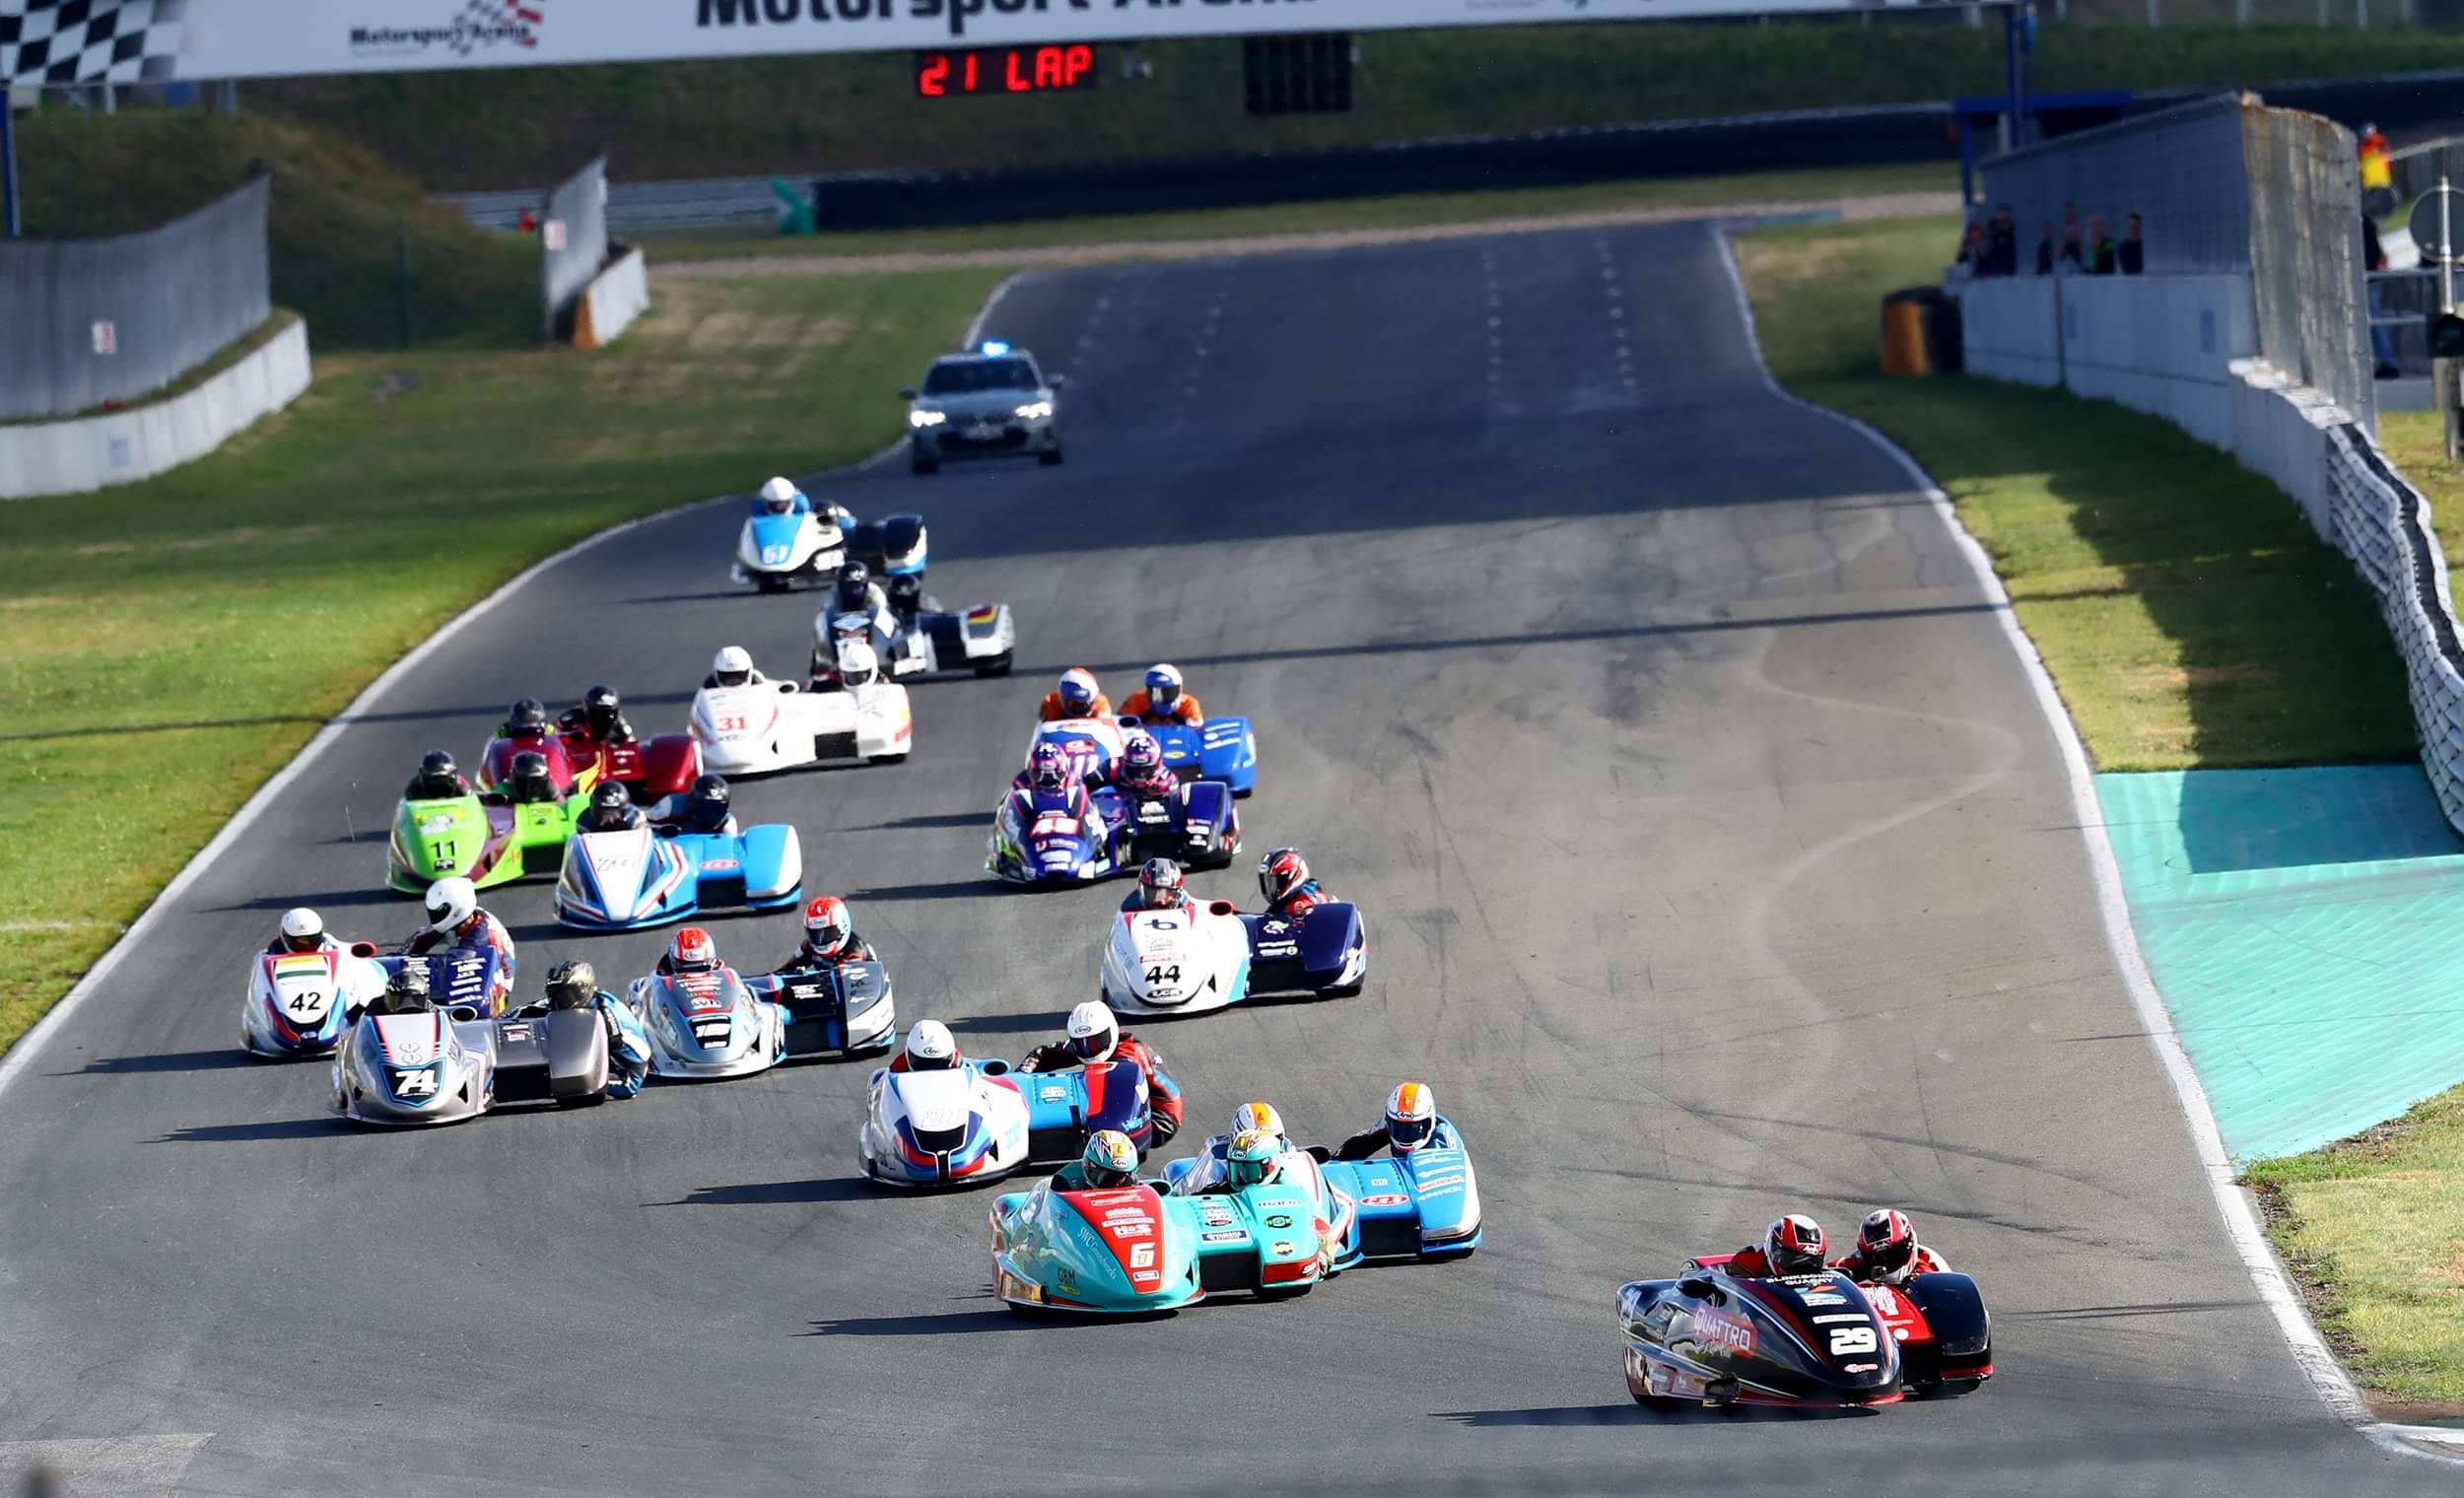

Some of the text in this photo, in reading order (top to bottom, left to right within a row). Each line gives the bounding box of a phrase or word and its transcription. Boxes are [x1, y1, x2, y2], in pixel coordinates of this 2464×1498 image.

[696, 0, 1090, 35] Motorsp
[919, 45, 1092, 96] 21 LAP
[718, 716, 746, 731] 31
[430, 841, 455, 858] 11
[1145, 965, 1181, 985] 44
[290, 991, 321, 1012] 42
[395, 1069, 439, 1095] 74
[1129, 1243, 1155, 1268] 6
[1694, 1307, 1751, 1351] QUATTRO
[1830, 1328, 1877, 1356] 29
